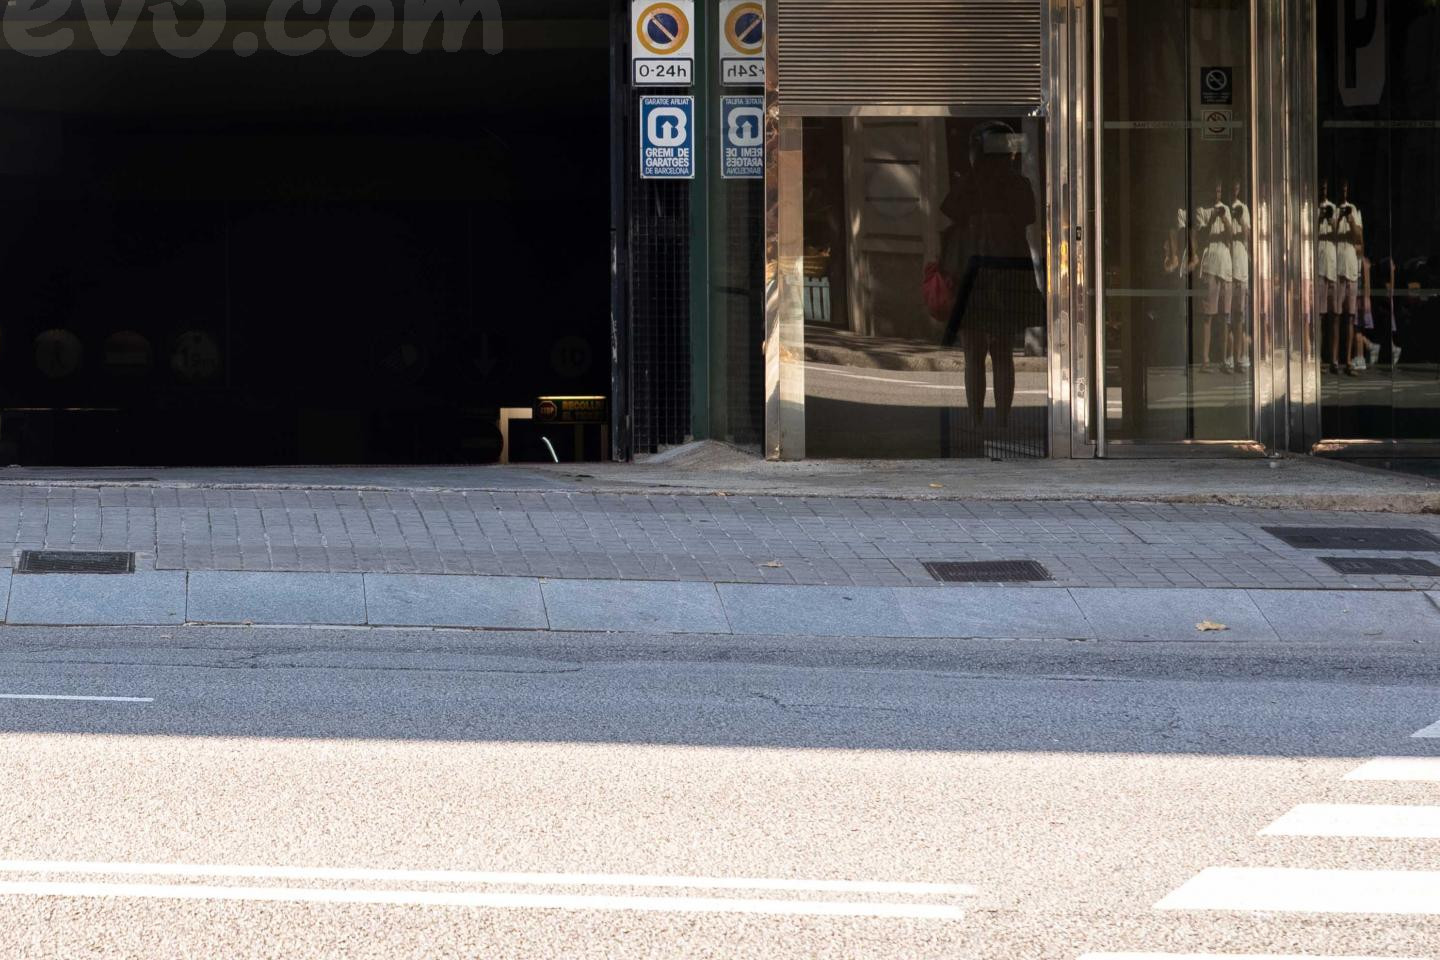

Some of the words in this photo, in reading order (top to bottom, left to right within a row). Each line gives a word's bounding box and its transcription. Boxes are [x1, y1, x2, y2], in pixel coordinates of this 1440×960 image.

[639, 64, 687, 77] 0-24h
[645, 148, 674, 157] GREMI
[677, 148, 689, 157] DE
[645, 158, 689, 167] GARATGES
[645, 167, 654, 175] DE
[654, 167, 689, 175] BARCELONA
